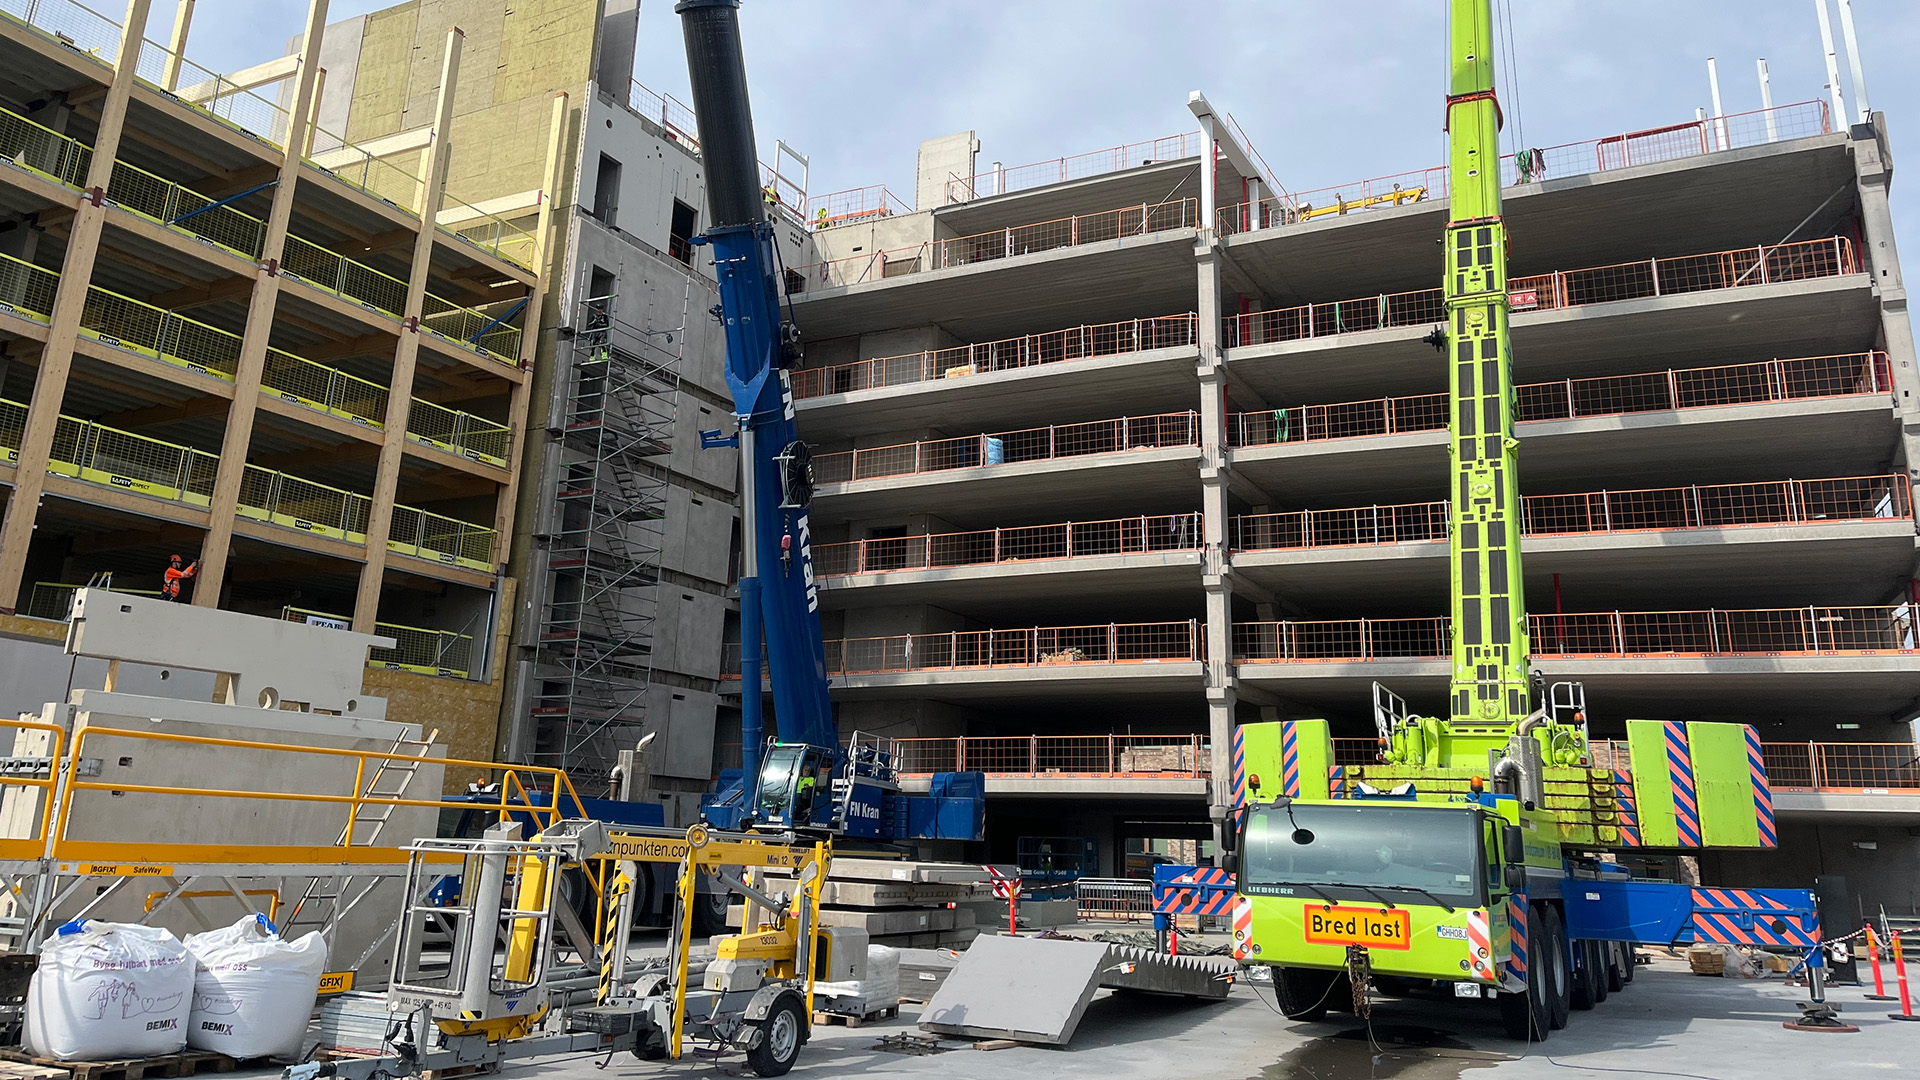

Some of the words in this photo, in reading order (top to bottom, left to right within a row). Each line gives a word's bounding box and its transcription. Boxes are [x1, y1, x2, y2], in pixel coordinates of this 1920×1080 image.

[779, 368, 795, 421] FN
[797, 514, 819, 614] Kran
[849, 801, 861, 817] FN
[861, 802, 880, 820] Kran
[766, 854, 780, 865] Mini
[781, 855, 789, 865] 12
[133, 866, 162, 875] SafeWay
[1247, 886, 1294, 895] LIEBHERR
[1312, 914, 1356, 934] Bred
[1364, 917, 1401, 938] last
[232, 963, 248, 972] oss
[146, 1017, 178, 1031] BEMIX
[201, 1021, 234, 1036] BEMIX
